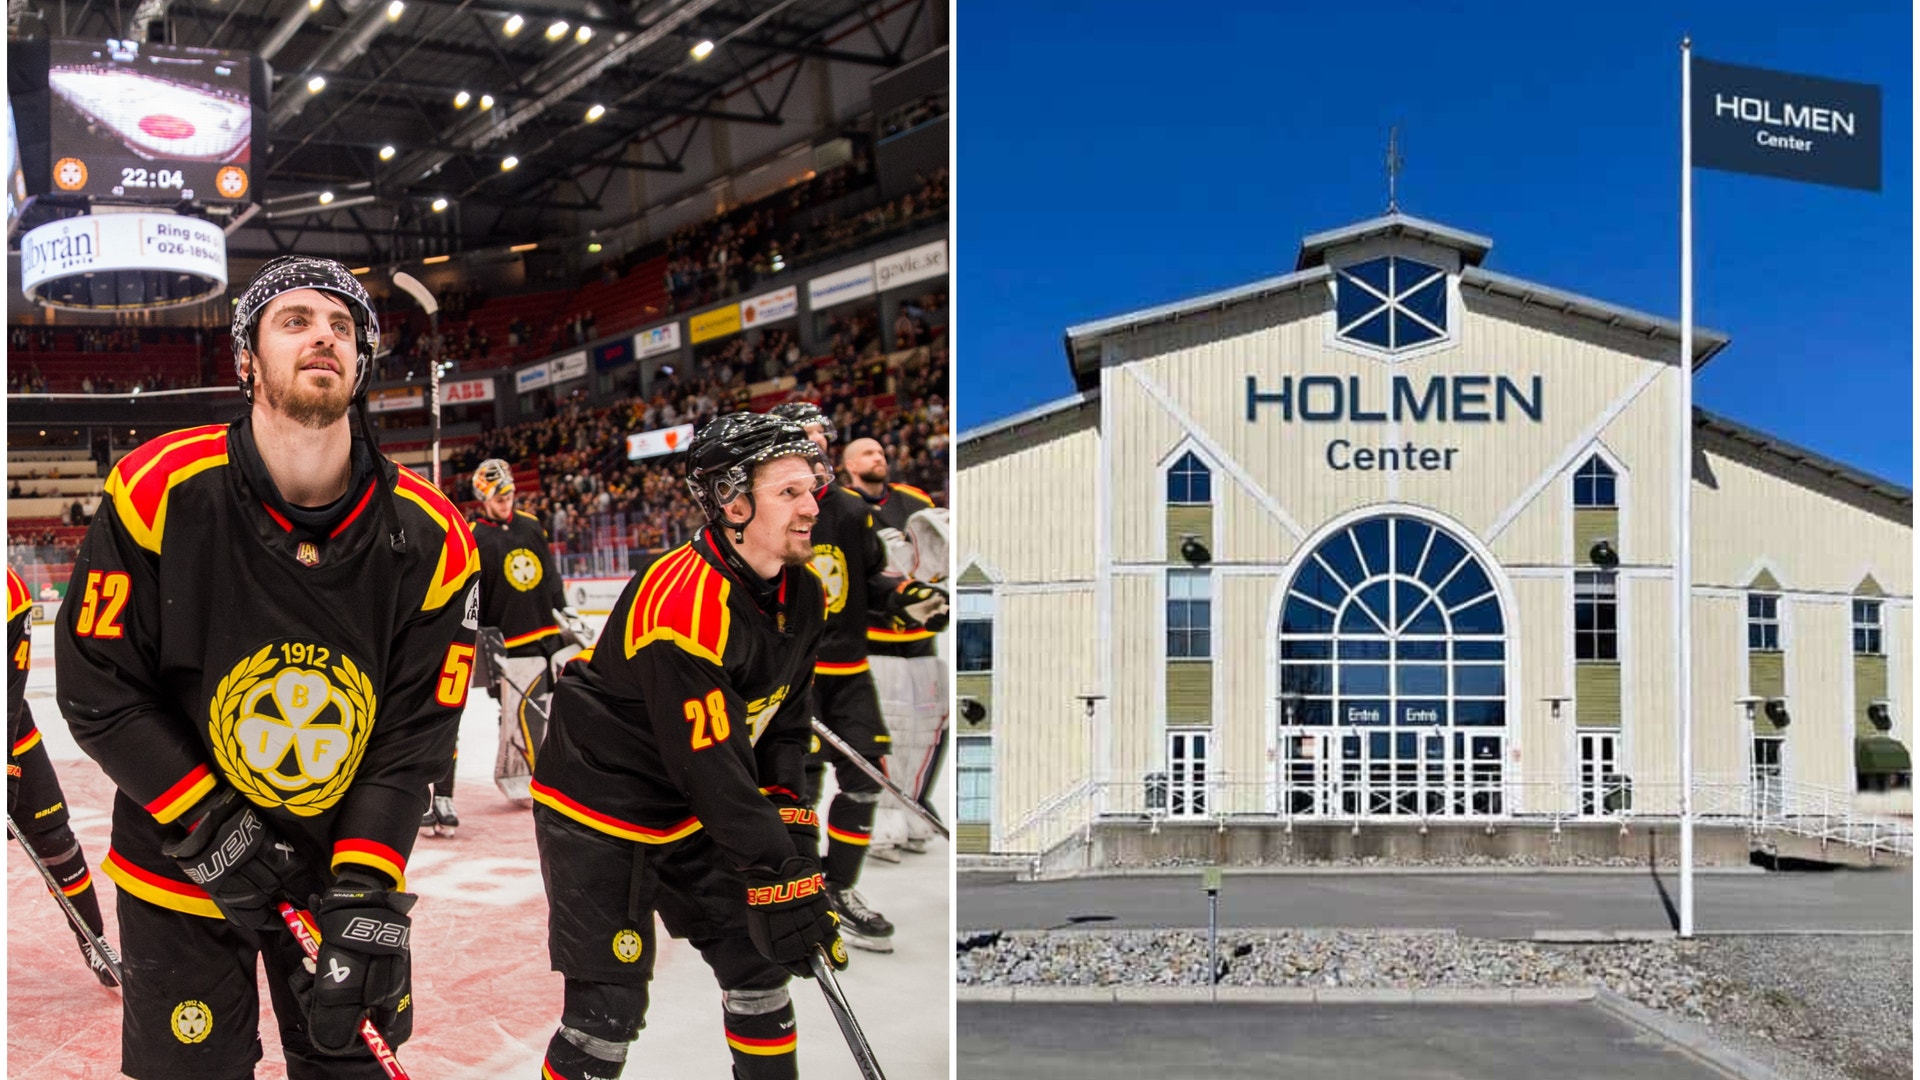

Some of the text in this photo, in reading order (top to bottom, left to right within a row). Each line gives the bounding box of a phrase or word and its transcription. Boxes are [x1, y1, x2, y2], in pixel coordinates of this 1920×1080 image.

[1715, 93, 1855, 136] HOLMEN
[1756, 130, 1812, 152] Center
[121, 167, 184, 189] 22:04
[157, 223, 190, 241] Ring
[447, 382, 485, 401] ABB
[1246, 375, 1543, 423] HOLMEN
[1326, 439, 1458, 471] Center
[76, 569, 132, 638] 52
[14, 640, 31, 671] 4
[280, 642, 330, 669] 1912
[435, 641, 476, 708] 5
[291, 684, 309, 708] B
[683, 688, 731, 752] 28
